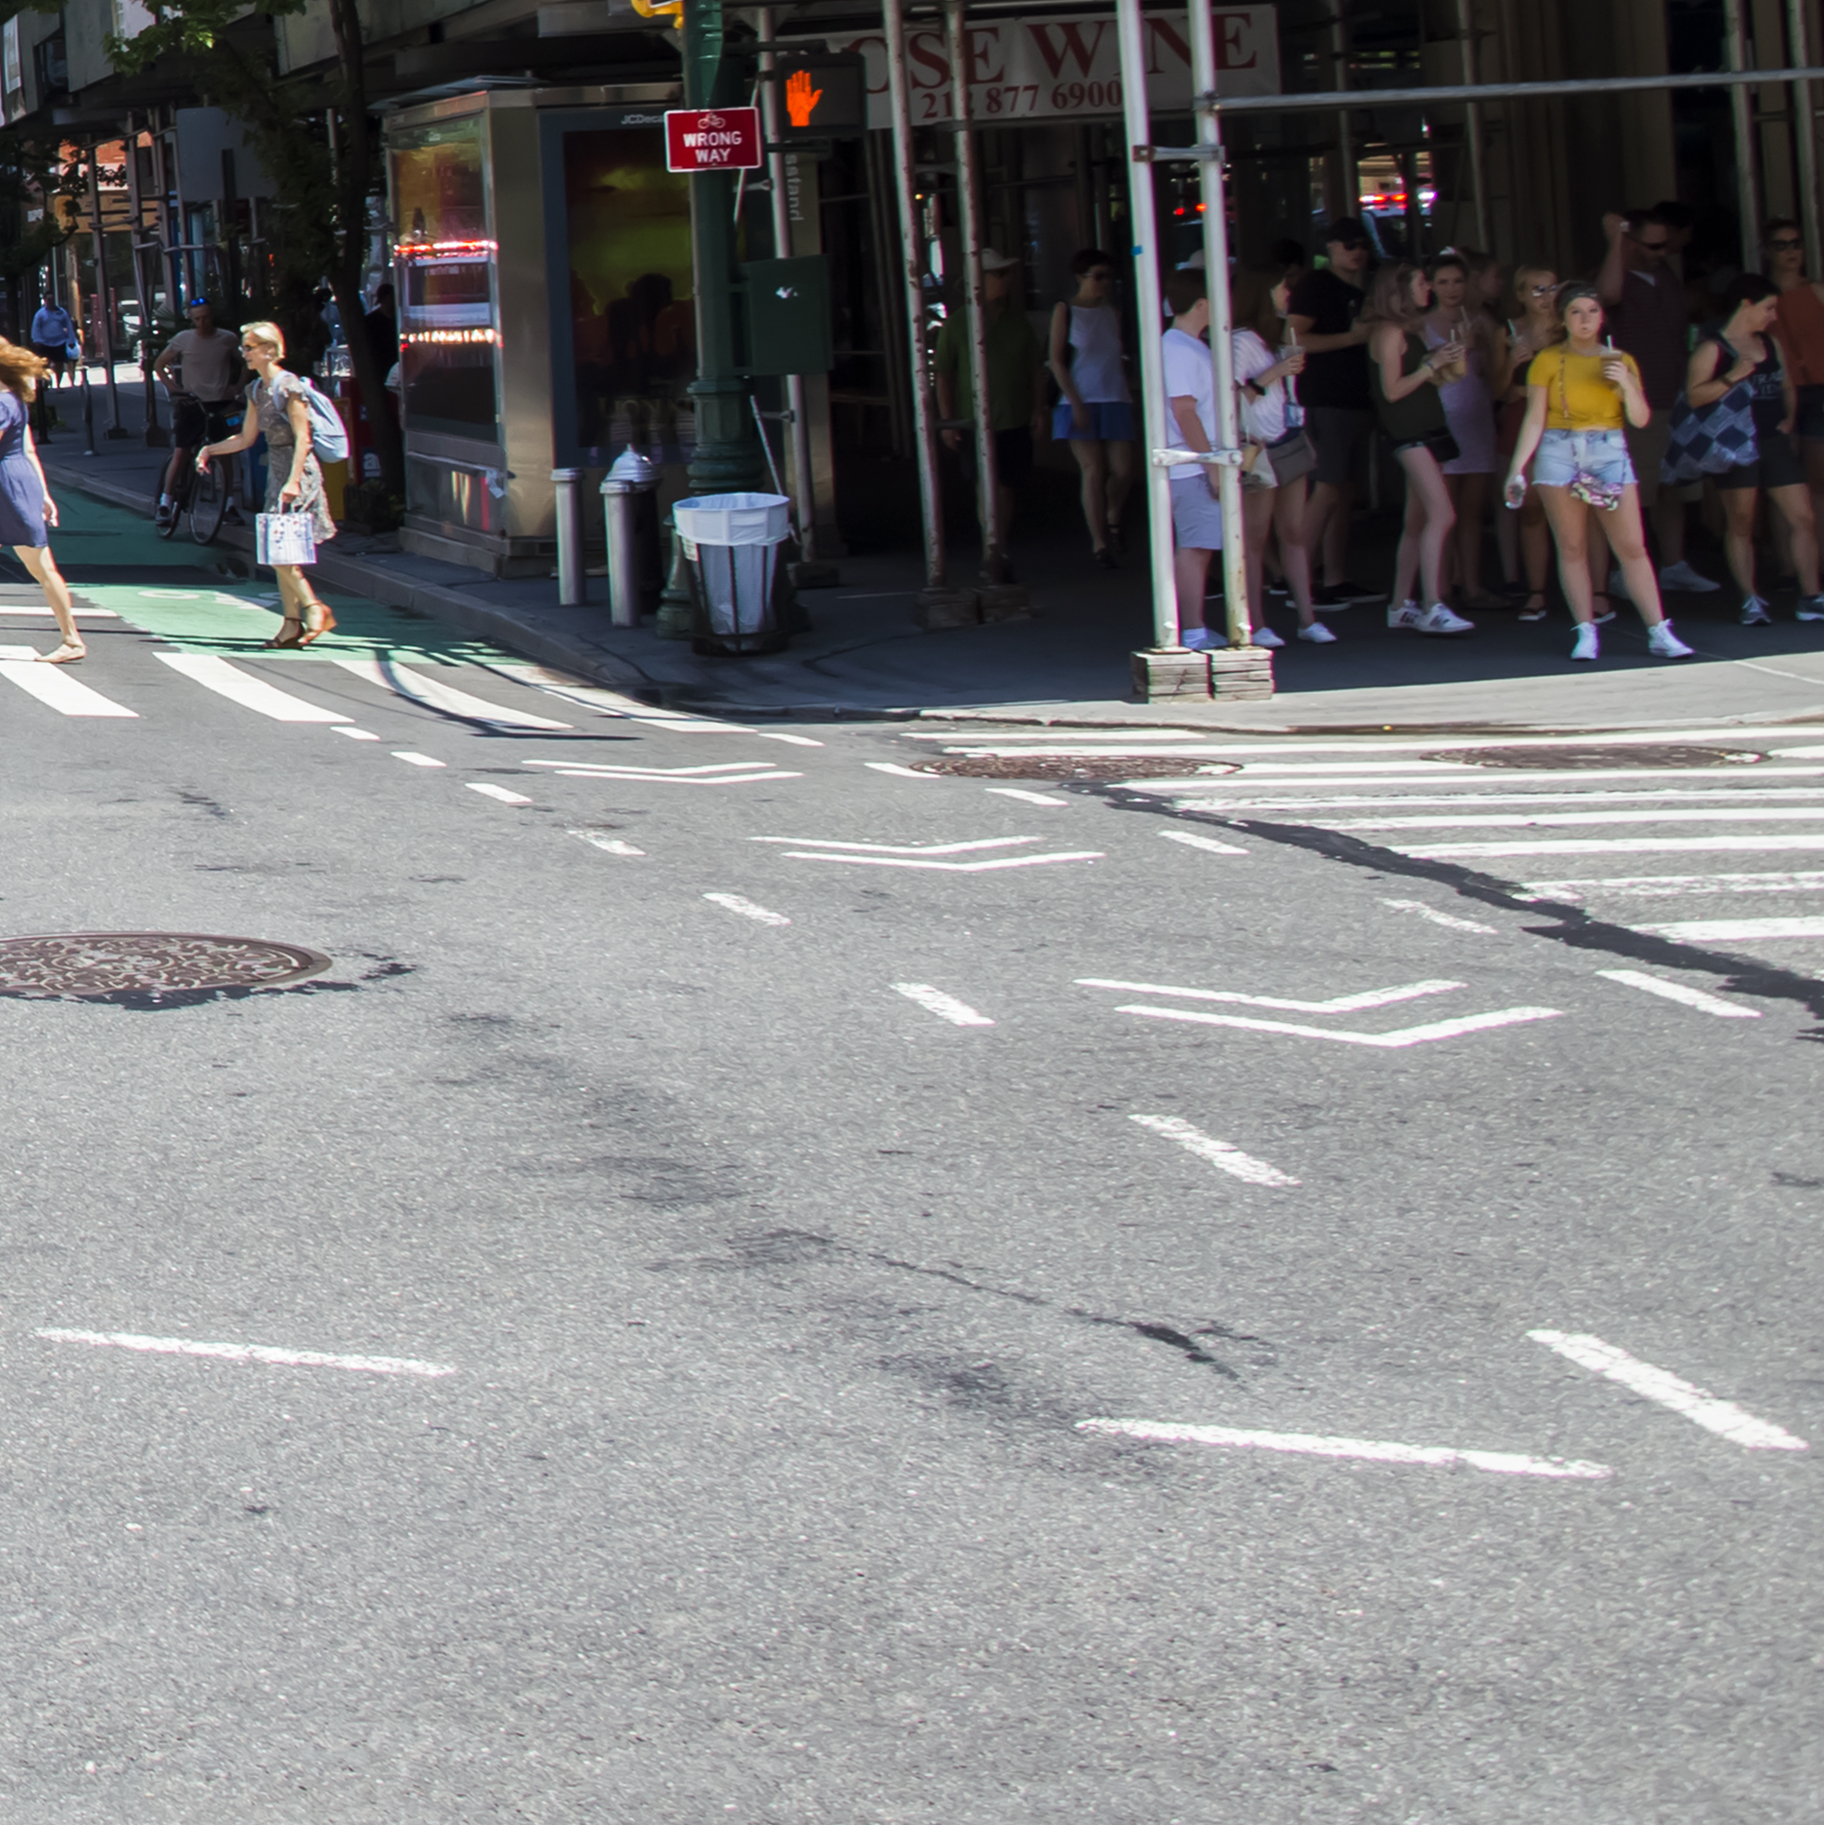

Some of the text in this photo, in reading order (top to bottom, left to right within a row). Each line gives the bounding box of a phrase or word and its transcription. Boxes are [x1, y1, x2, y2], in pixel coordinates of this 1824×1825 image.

[850, 13, 1257, 95] OSE WNE
[921, 80, 1123, 119] 21 877 6900
[682, 130, 743, 148] WRONG
[694, 147, 732, 164] WAY
